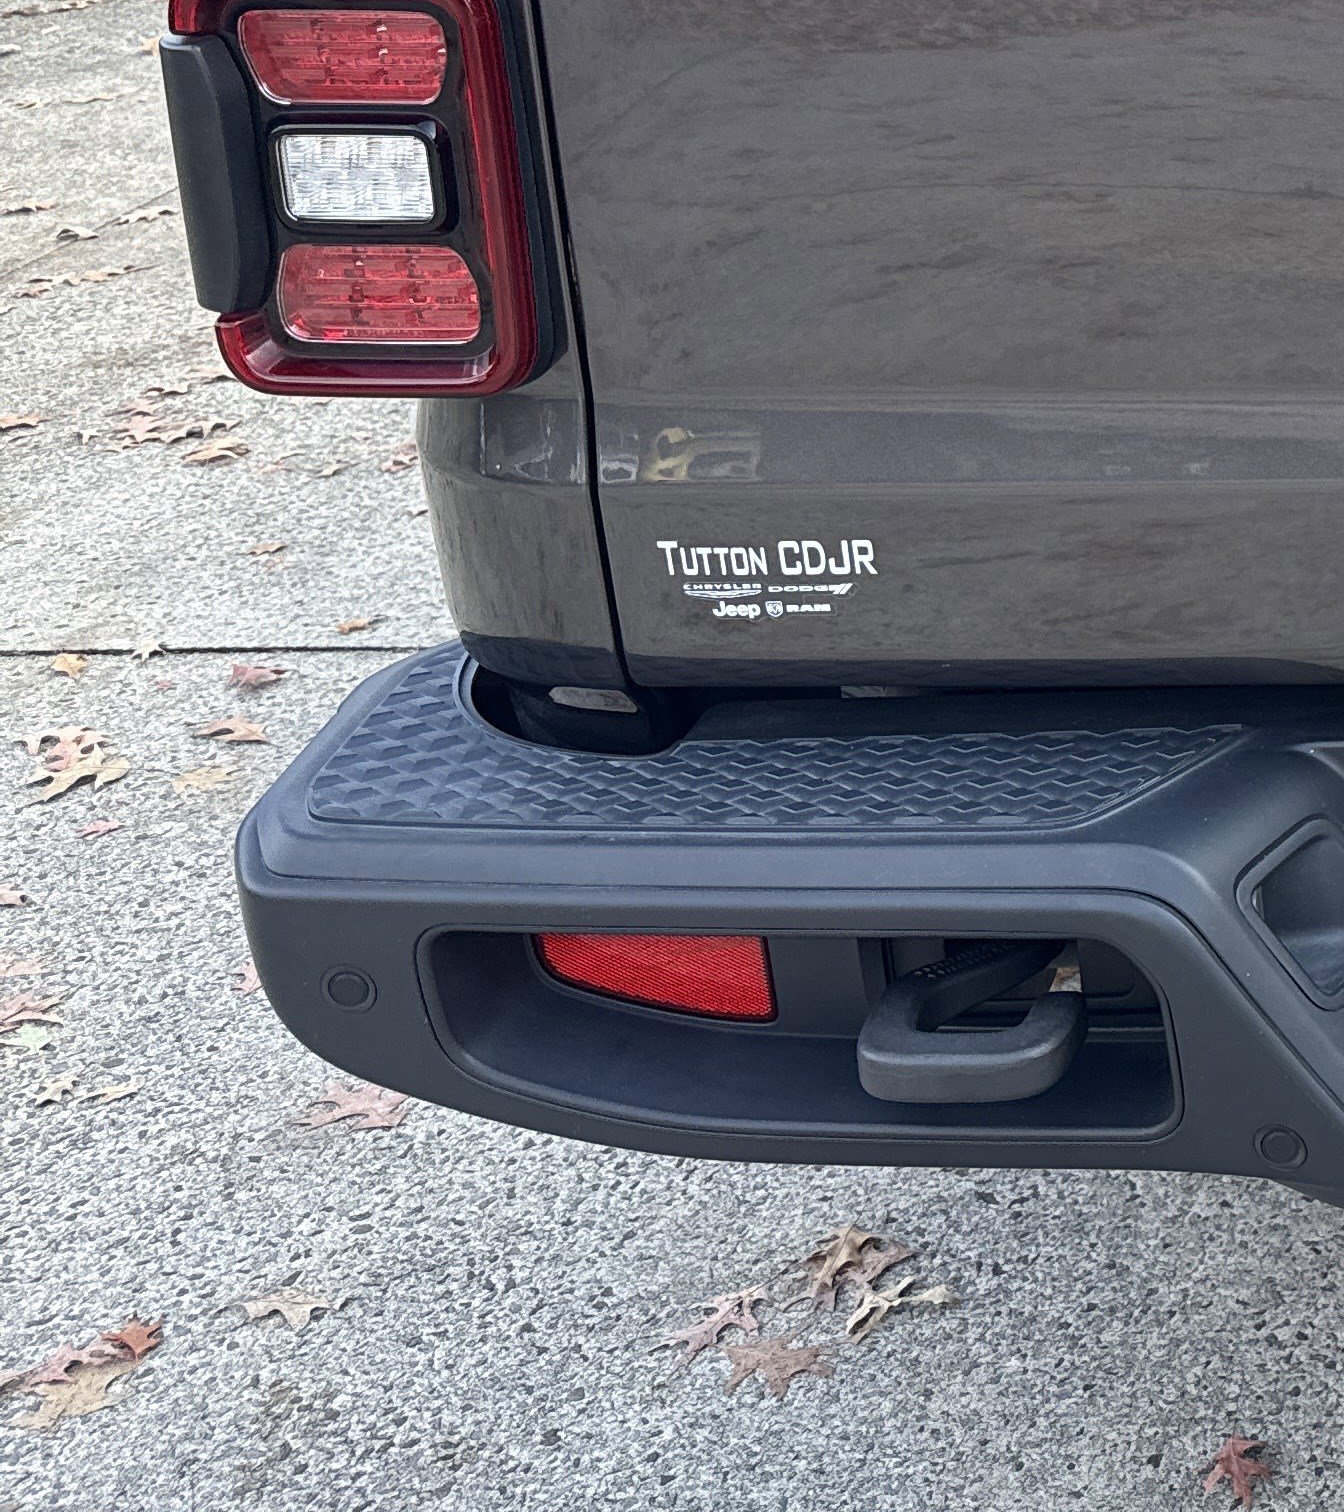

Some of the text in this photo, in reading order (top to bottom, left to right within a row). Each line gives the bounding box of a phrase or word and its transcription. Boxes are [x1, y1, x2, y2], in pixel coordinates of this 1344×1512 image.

[656, 538, 878, 577] TUTTON CDJR
[711, 600, 832, 619] Jeep RAM
